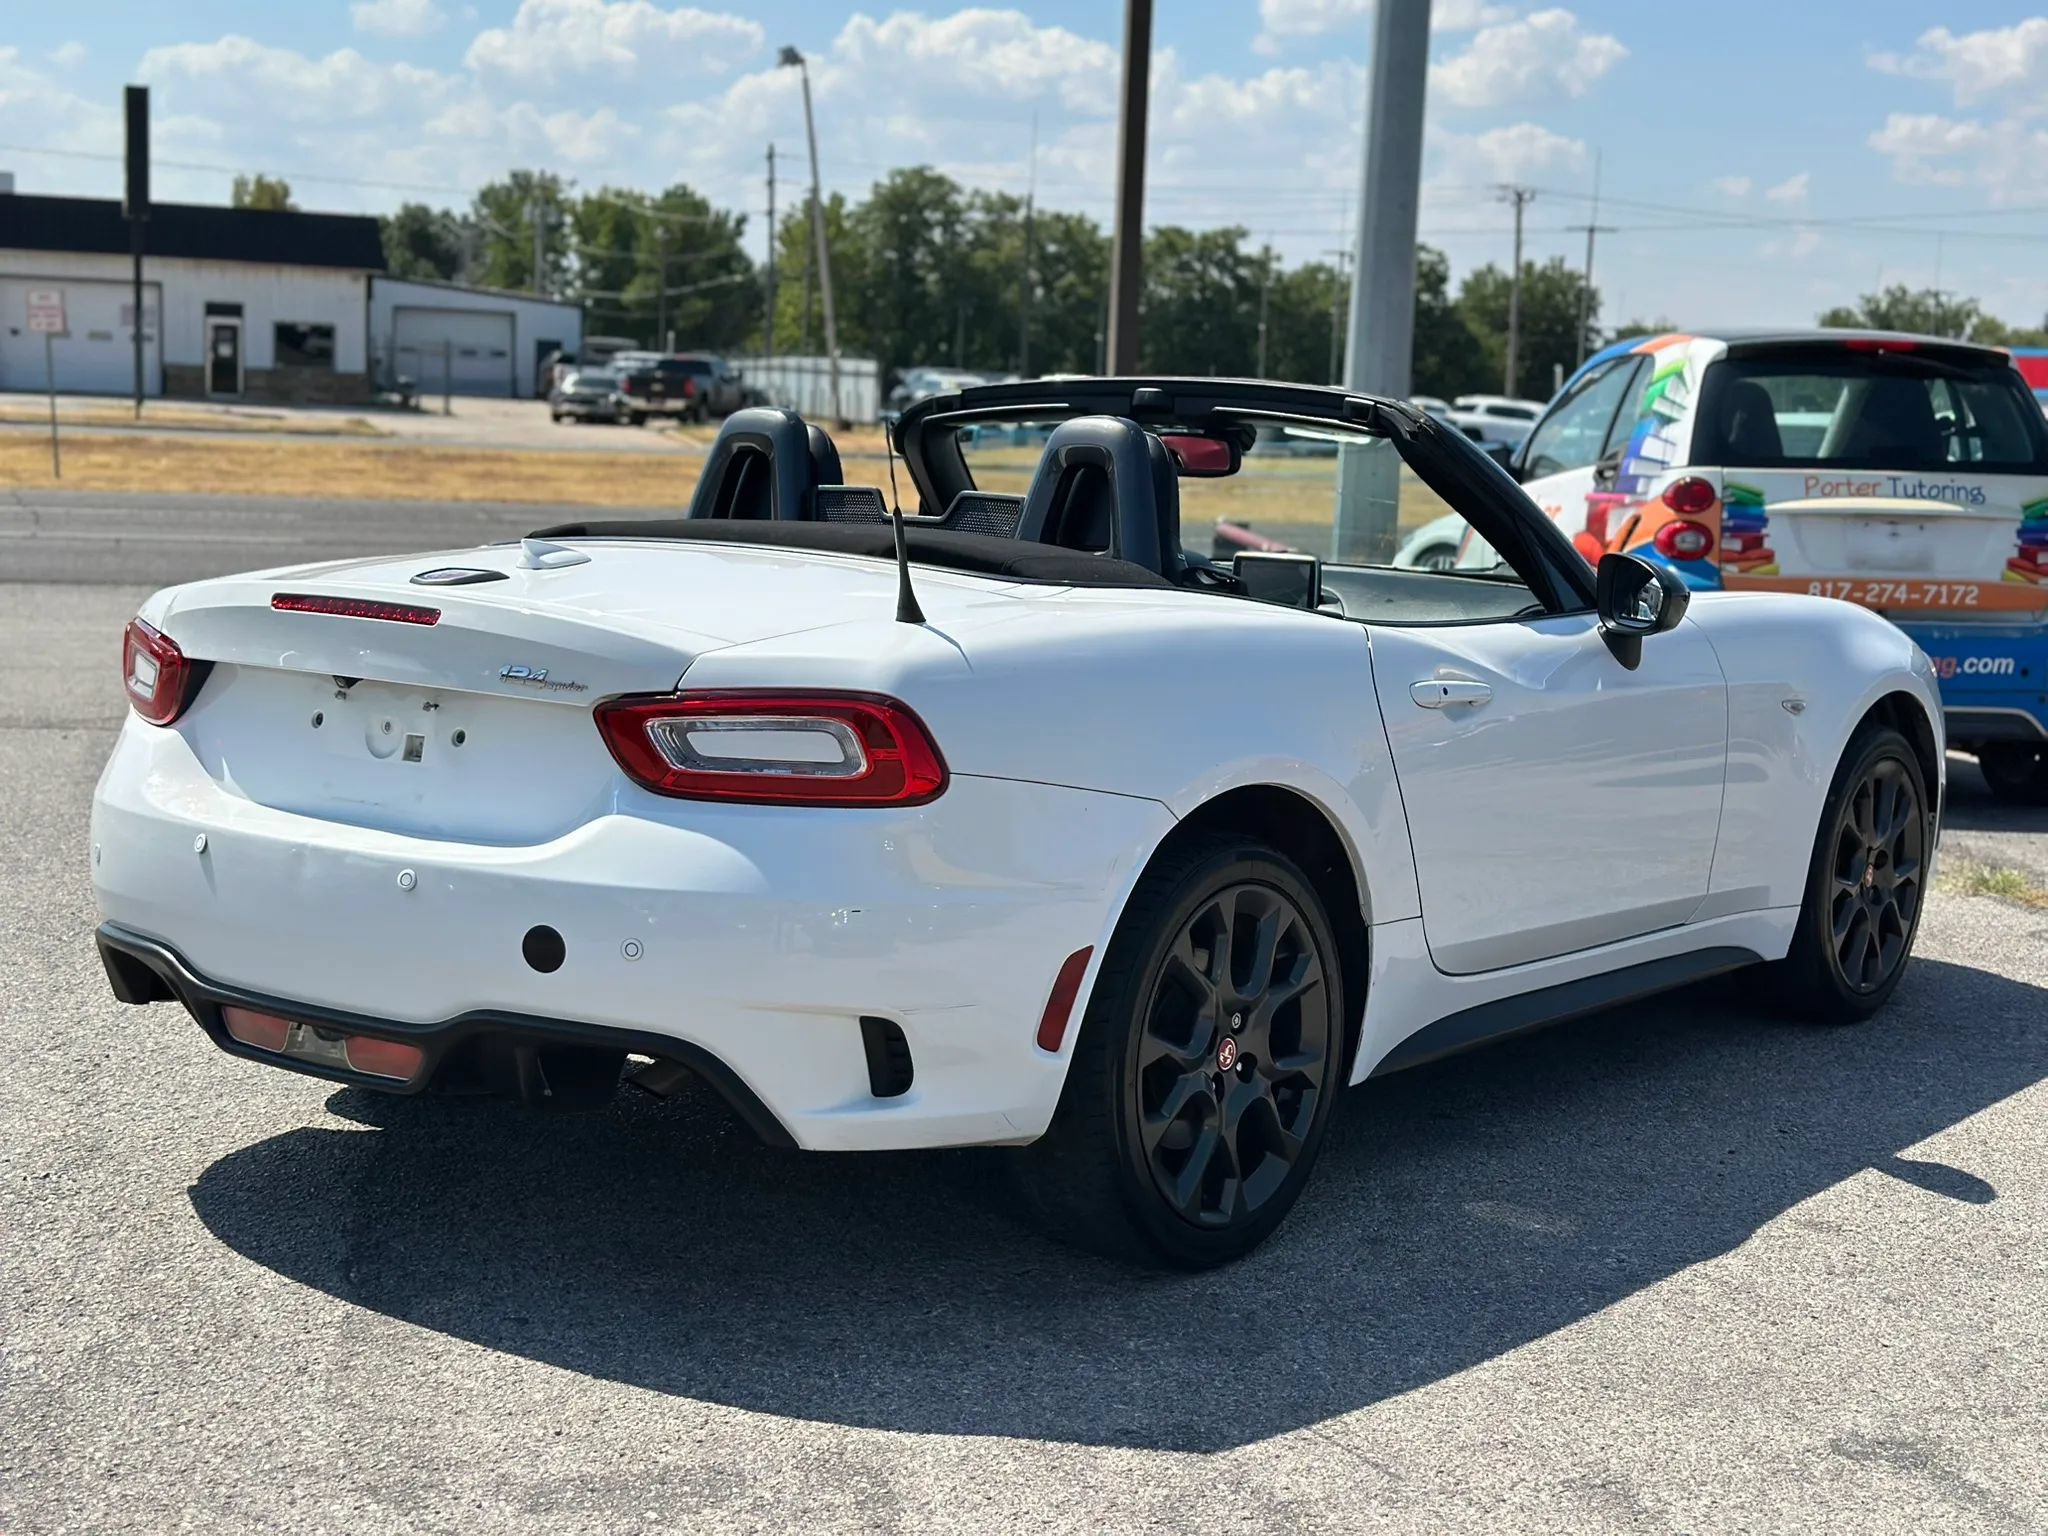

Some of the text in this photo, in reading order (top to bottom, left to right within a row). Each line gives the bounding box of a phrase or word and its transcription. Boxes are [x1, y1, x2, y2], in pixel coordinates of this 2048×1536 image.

[1804, 476, 1986, 505] Porter Tutoring
[1808, 580, 1979, 606] 817-274-7172
